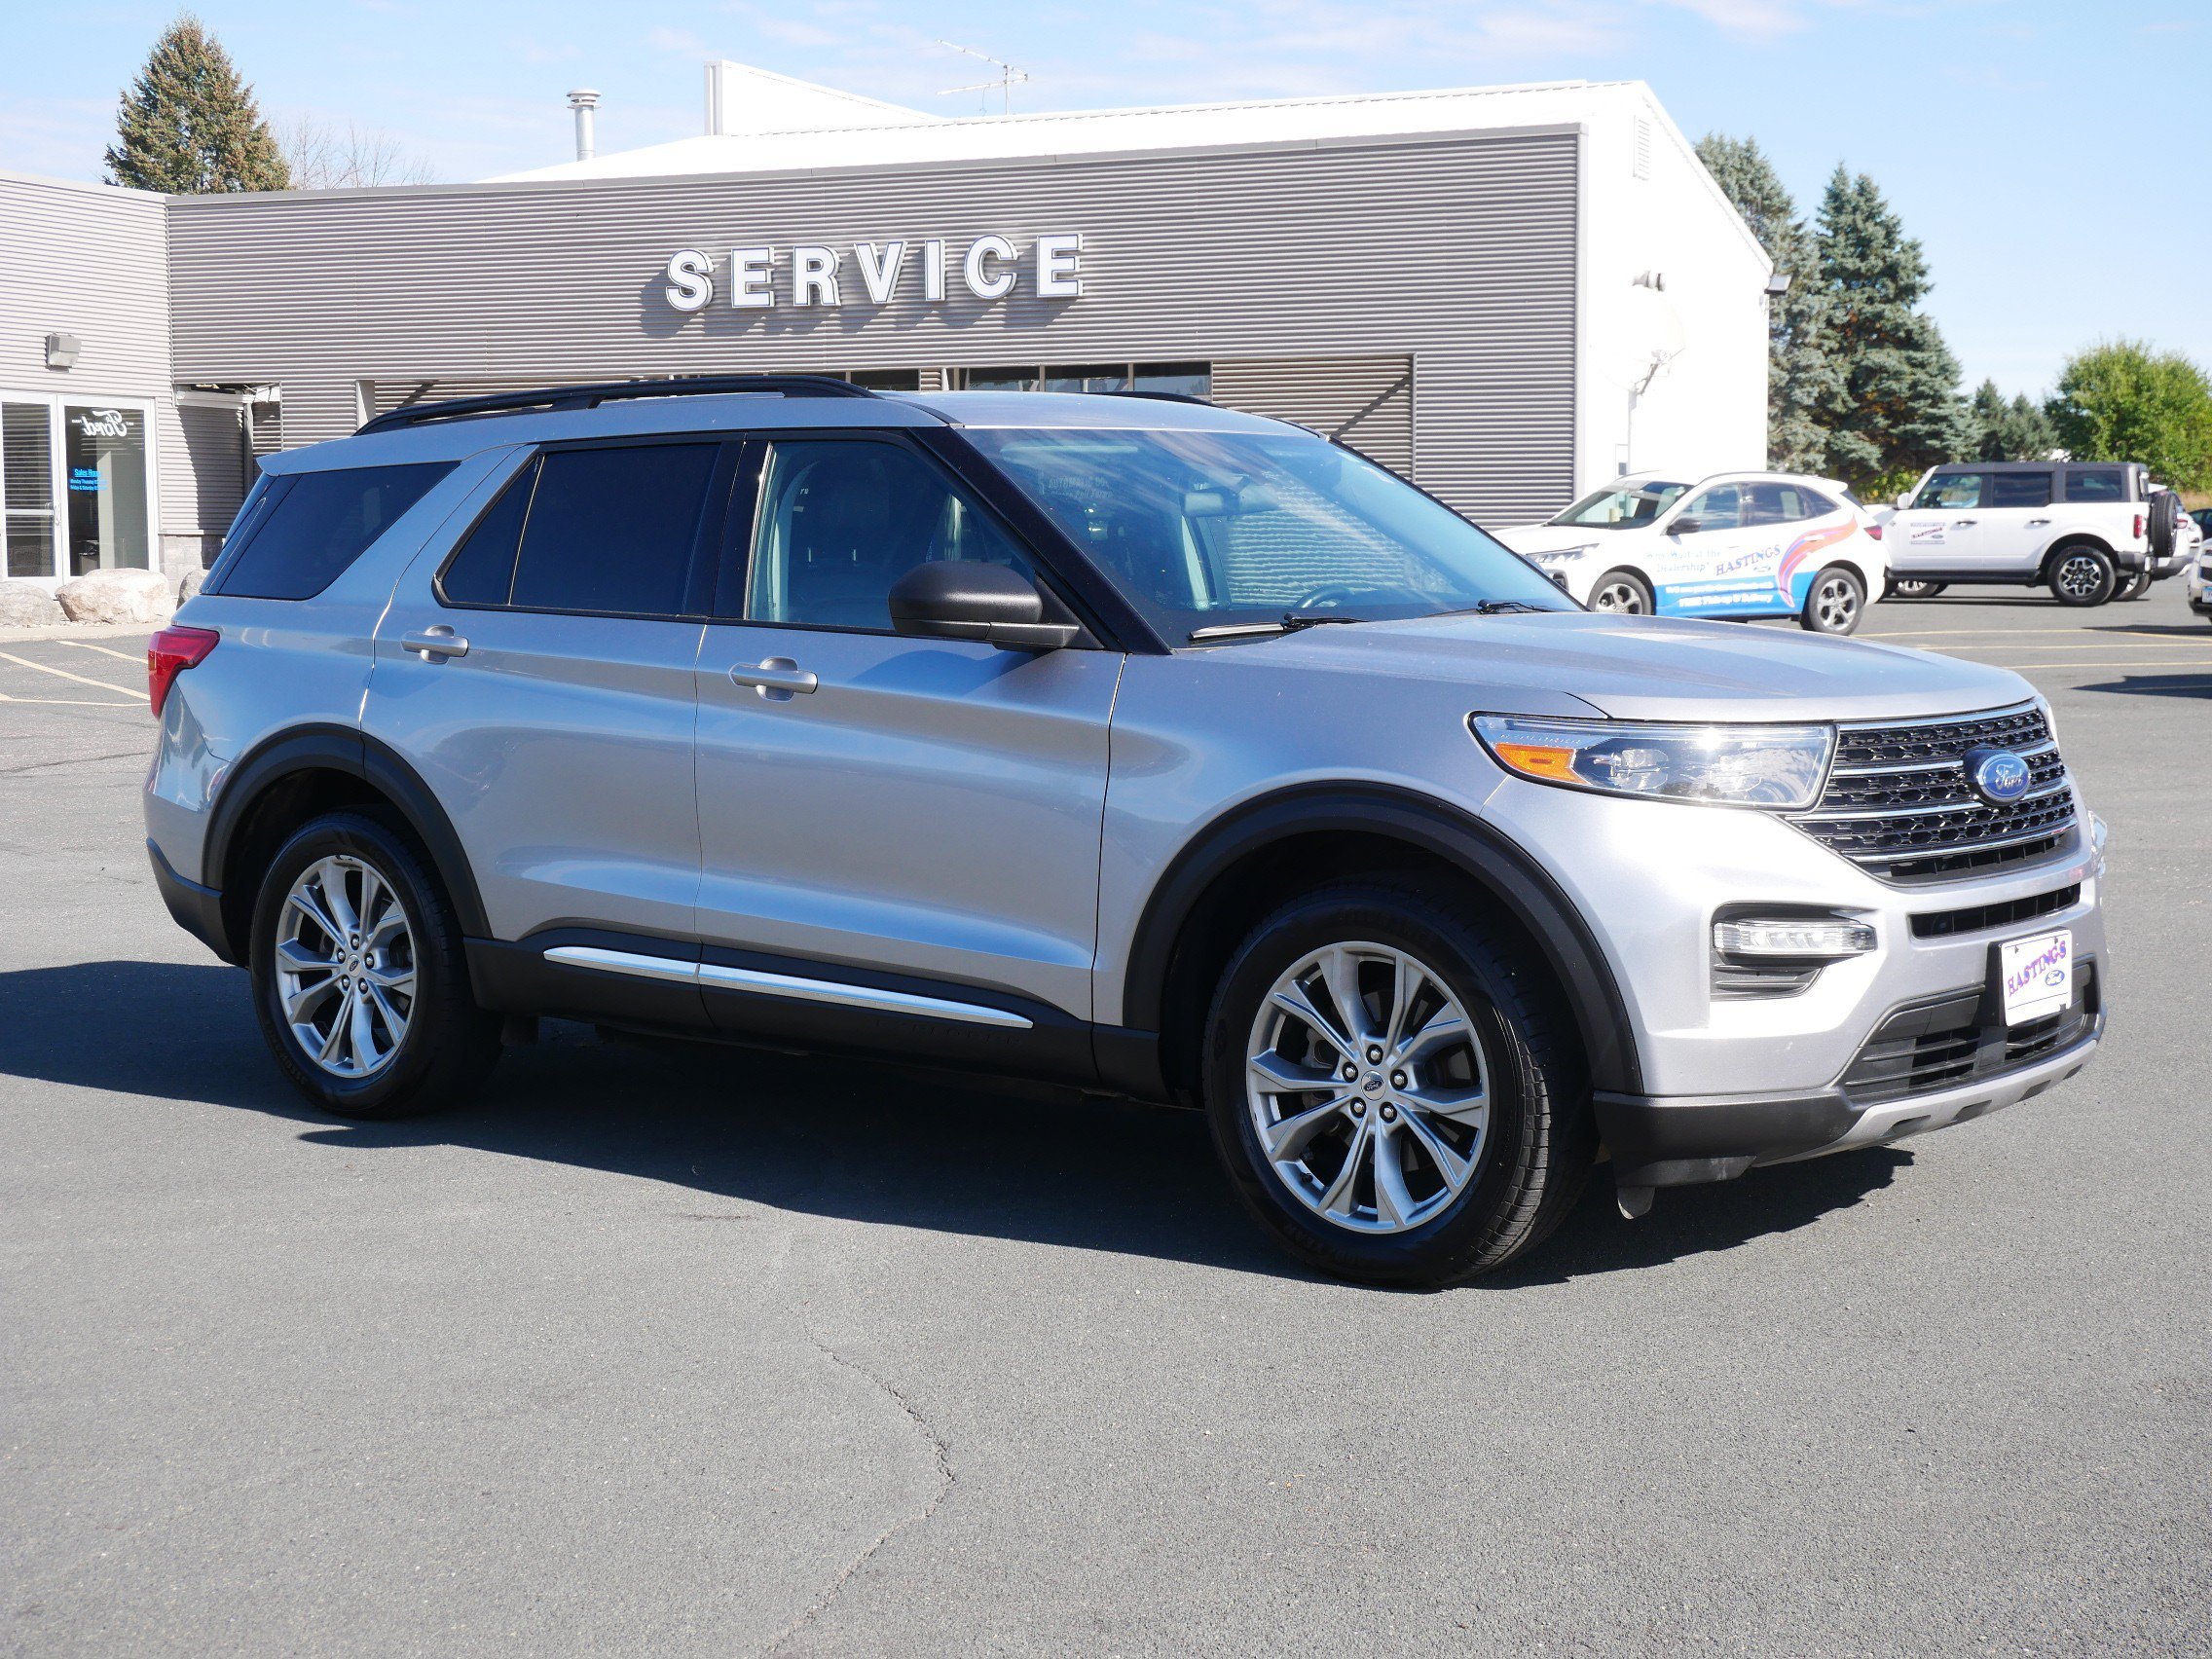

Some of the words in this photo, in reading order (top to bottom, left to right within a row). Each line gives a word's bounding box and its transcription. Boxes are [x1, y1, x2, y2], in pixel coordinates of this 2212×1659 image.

[665, 233, 1084, 312] SERVICE
[1715, 544, 1781, 576] HASTINGS
[1995, 763, 2023, 791] Ford
[2008, 940, 2067, 998] HASTINGS
